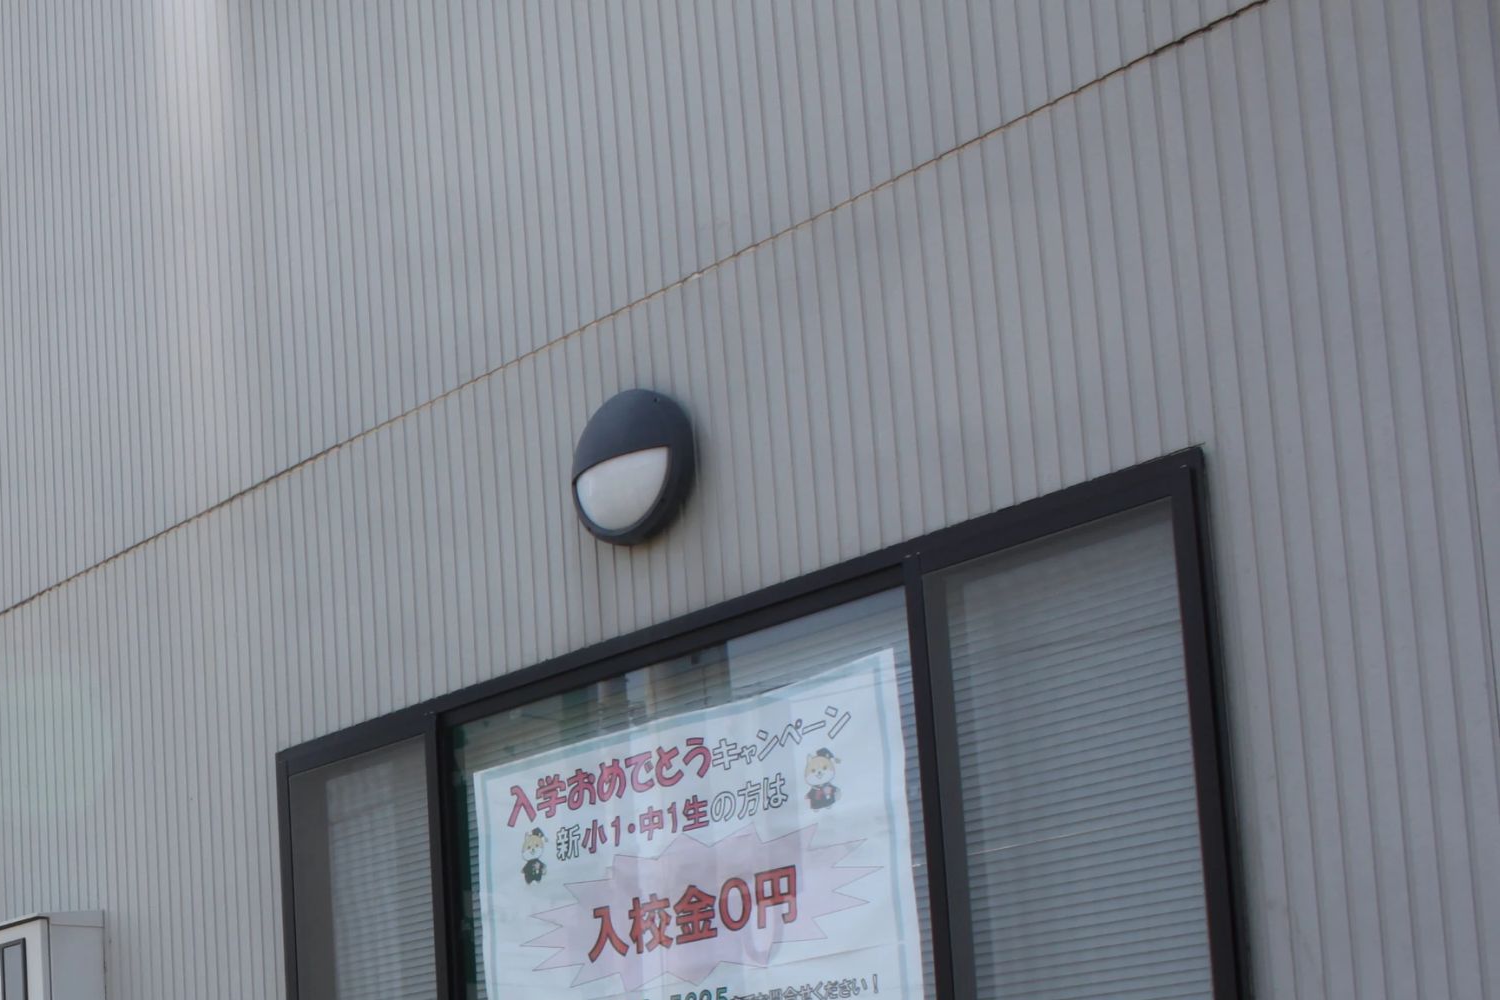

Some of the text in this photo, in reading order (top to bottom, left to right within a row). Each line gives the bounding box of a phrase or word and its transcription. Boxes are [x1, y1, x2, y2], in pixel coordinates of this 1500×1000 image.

[507, 705, 852, 828] 入学おめでとうキャンペーン
[555, 772, 789, 862] 新小1・中1生の方は
[587, 864, 798, 963] 入校金0円
